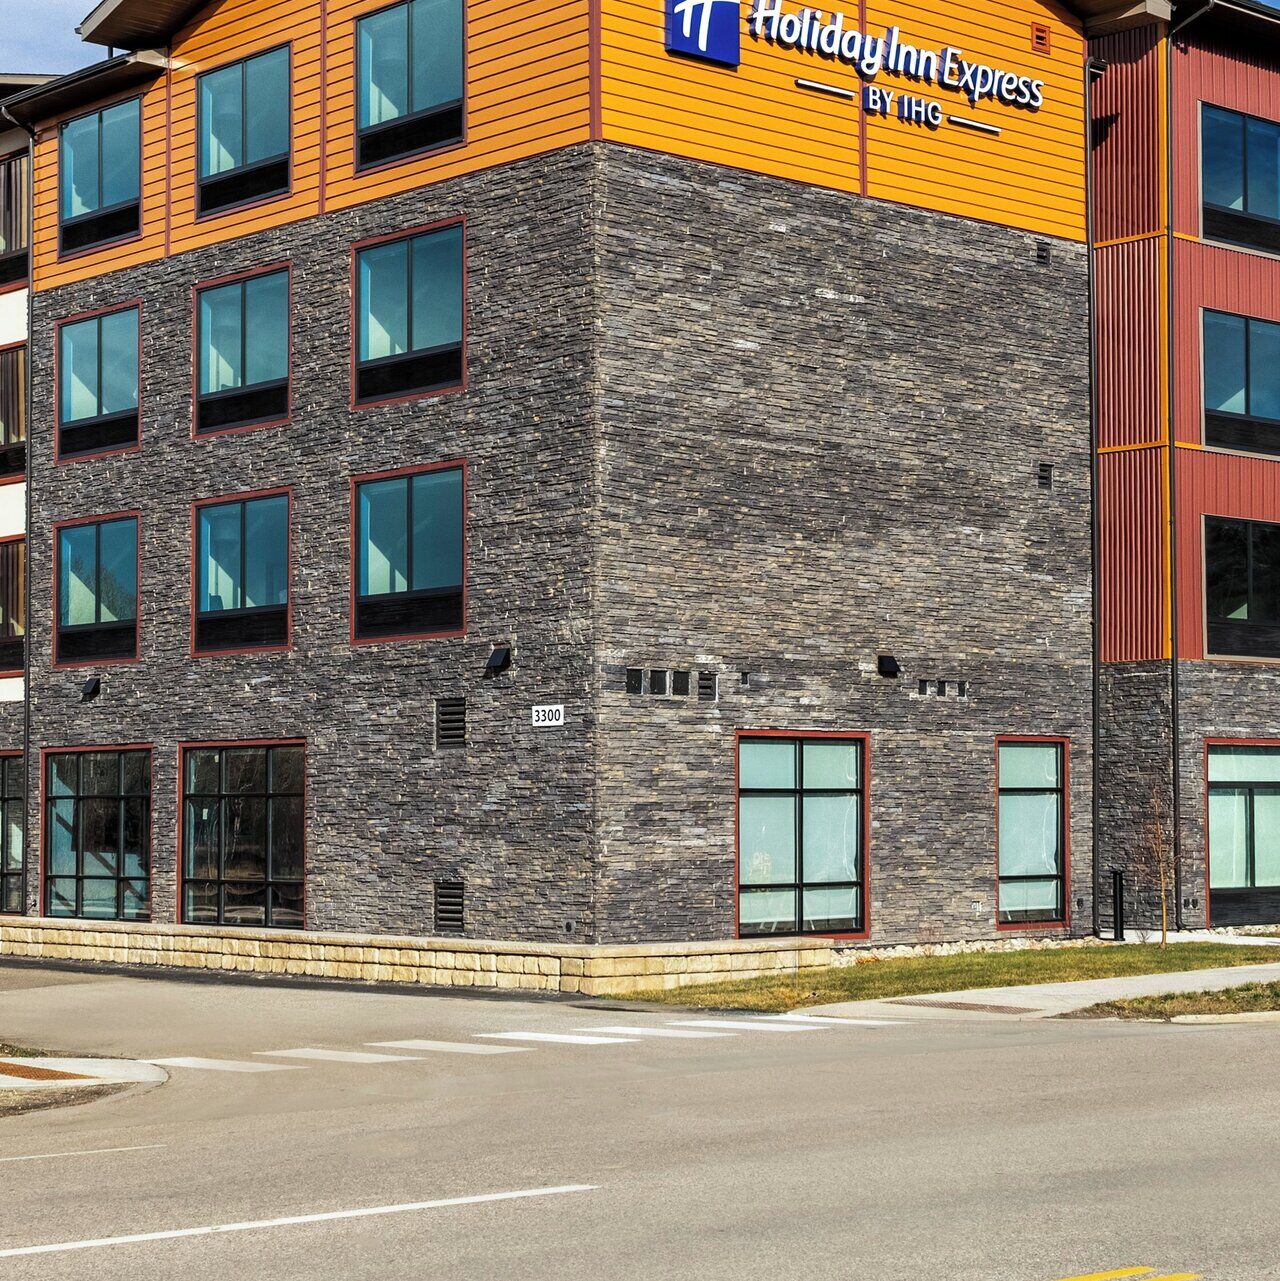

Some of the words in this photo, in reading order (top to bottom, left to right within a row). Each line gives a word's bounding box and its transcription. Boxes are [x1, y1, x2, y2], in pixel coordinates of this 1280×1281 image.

[888, 26, 937, 80] Inn
[943, 47, 1045, 107] Express
[869, 86, 894, 113] BY
[904, 95, 942, 125] IHG
[534, 709, 561, 722] 3300
